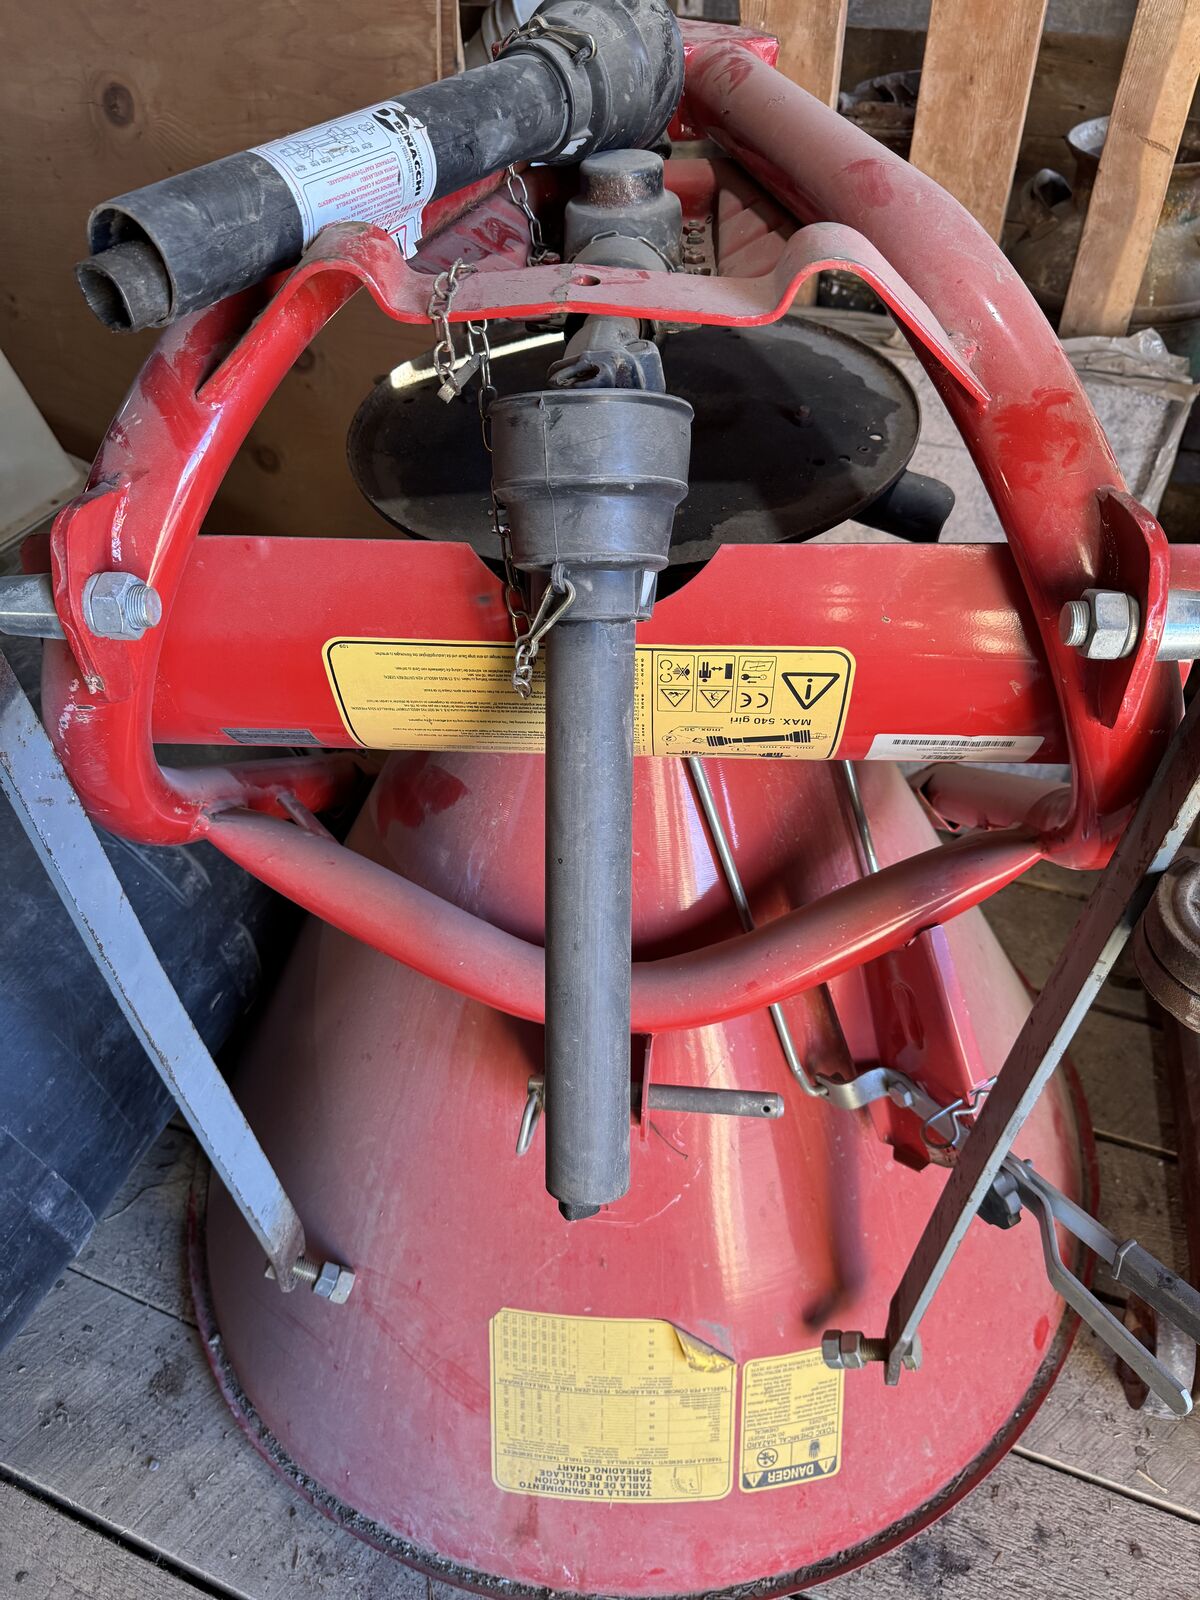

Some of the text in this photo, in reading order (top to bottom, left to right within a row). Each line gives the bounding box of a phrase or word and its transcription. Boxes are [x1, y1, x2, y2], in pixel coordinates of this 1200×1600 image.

[729, 715, 812, 727] MAX. 540 giri
[538, 1469, 653, 1483] TABLEAU DE REGLAGE
[557, 1464, 653, 1476] SPREADING CHART
[768, 1464, 814, 1483] DANGER
[519, 1481, 653, 1497] TABELLA DI SPANDIMENTO
[603, 1481, 617, 1490] DE
[619, 1482, 653, 1490] TABLA
